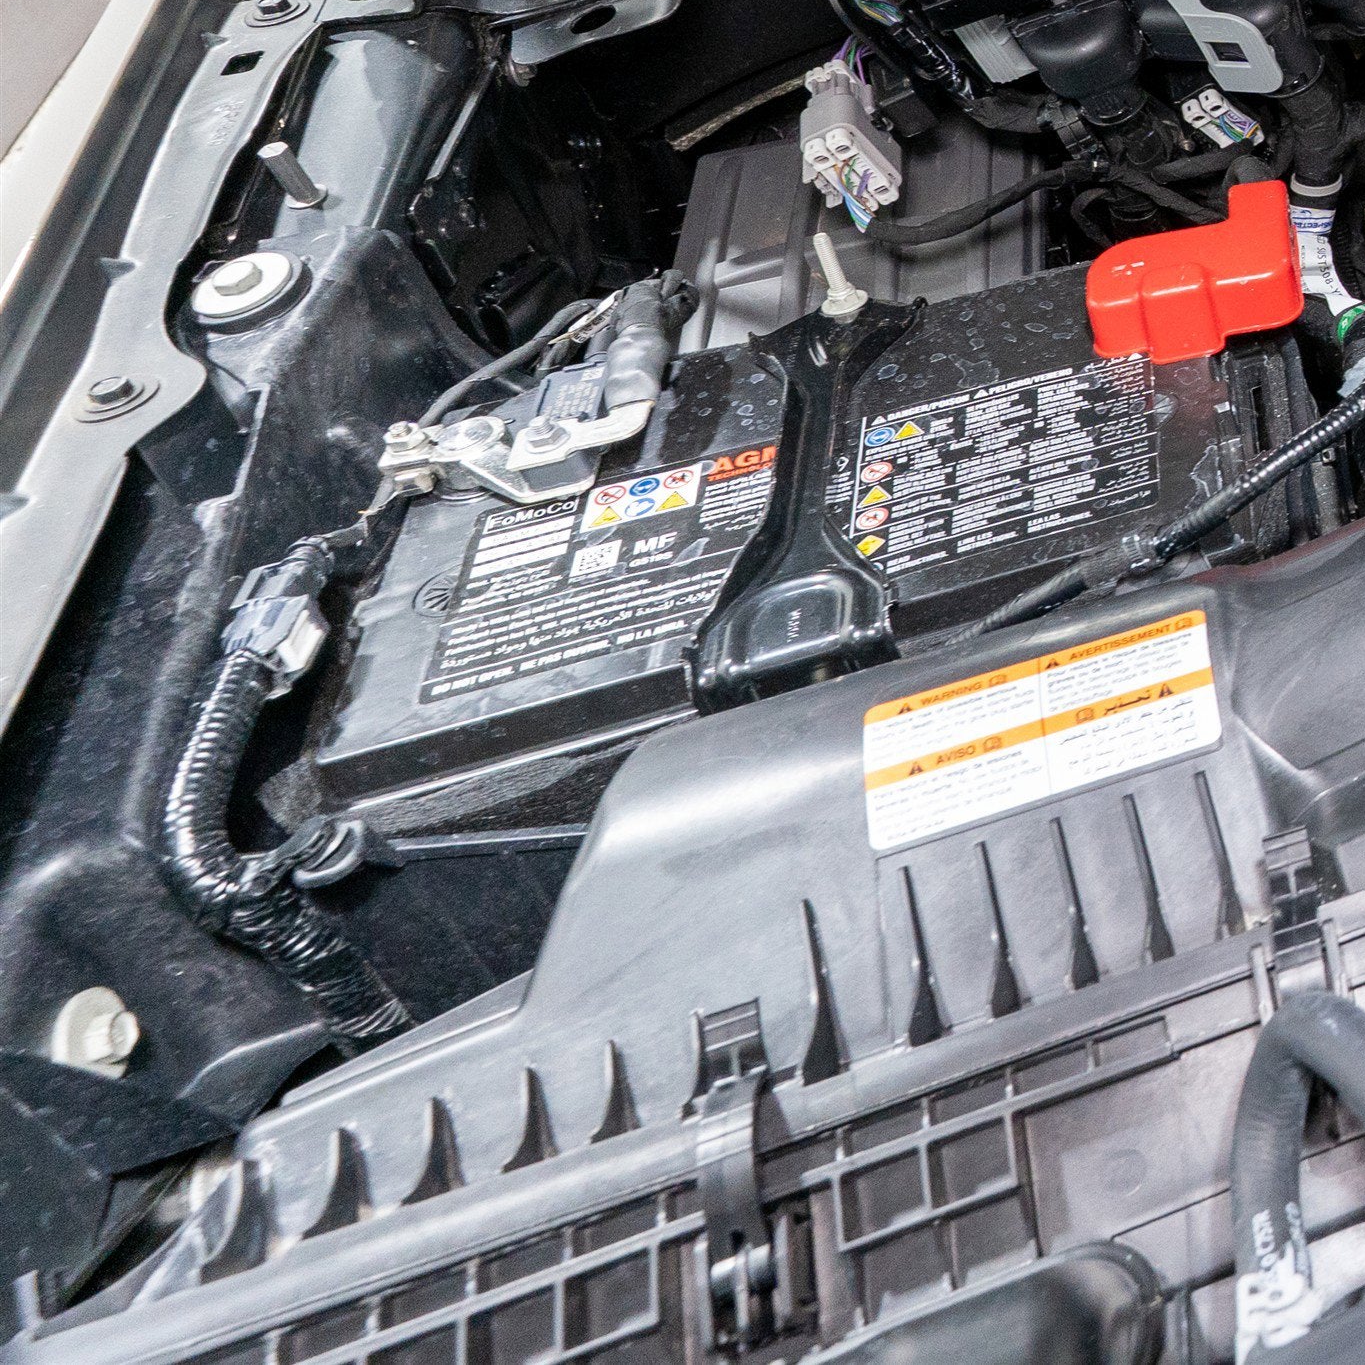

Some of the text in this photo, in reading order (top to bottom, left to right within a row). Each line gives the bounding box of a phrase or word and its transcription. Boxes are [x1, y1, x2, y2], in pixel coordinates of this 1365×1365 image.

[985, 367, 1074, 395] PELIGRO/VENENO
[885, 393, 971, 422] DANGER/POISON
[486, 499, 576, 528] FoMoCo
[630, 531, 679, 554] MF
[1065, 622, 1174, 661] AVERTISSEMENT
[537, 652, 562, 667] PAS
[450, 675, 477, 690] NOT
[477, 666, 514, 683] OPEN.
[919, 679, 984, 706] WARNING
[933, 743, 978, 766] AVISO
